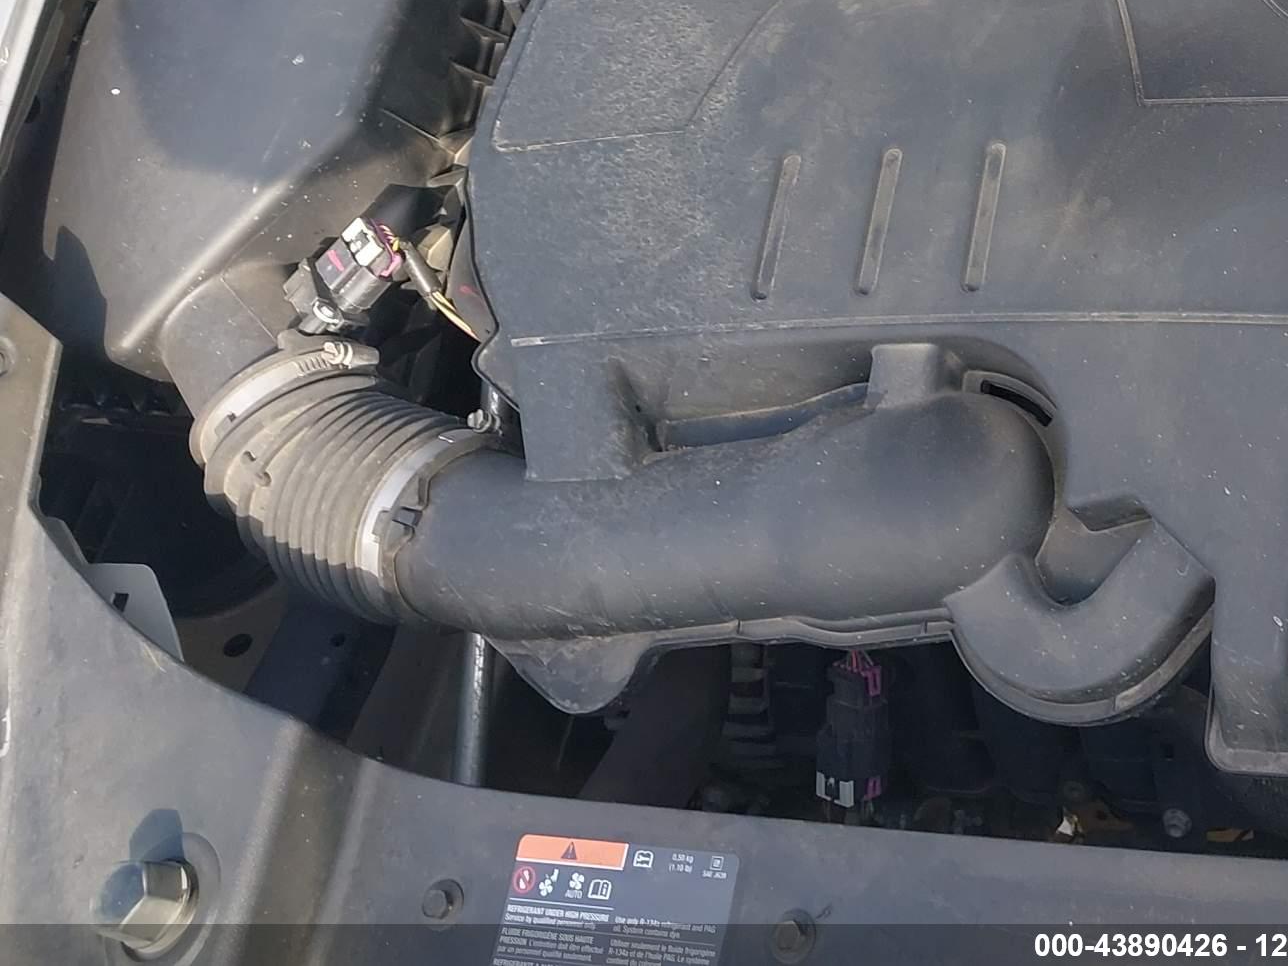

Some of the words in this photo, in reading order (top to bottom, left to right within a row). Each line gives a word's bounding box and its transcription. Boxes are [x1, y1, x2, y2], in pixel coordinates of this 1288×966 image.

[565, 889, 583, 899] AUTO
[504, 913, 525, 922] Service
[507, 904, 545, 915] REFRIGERANT
[544, 908, 564, 918] UNDER
[565, 910, 579, 919] HIGH
[579, 912, 610, 922] PRESSURE
[614, 916, 626, 924] Use
